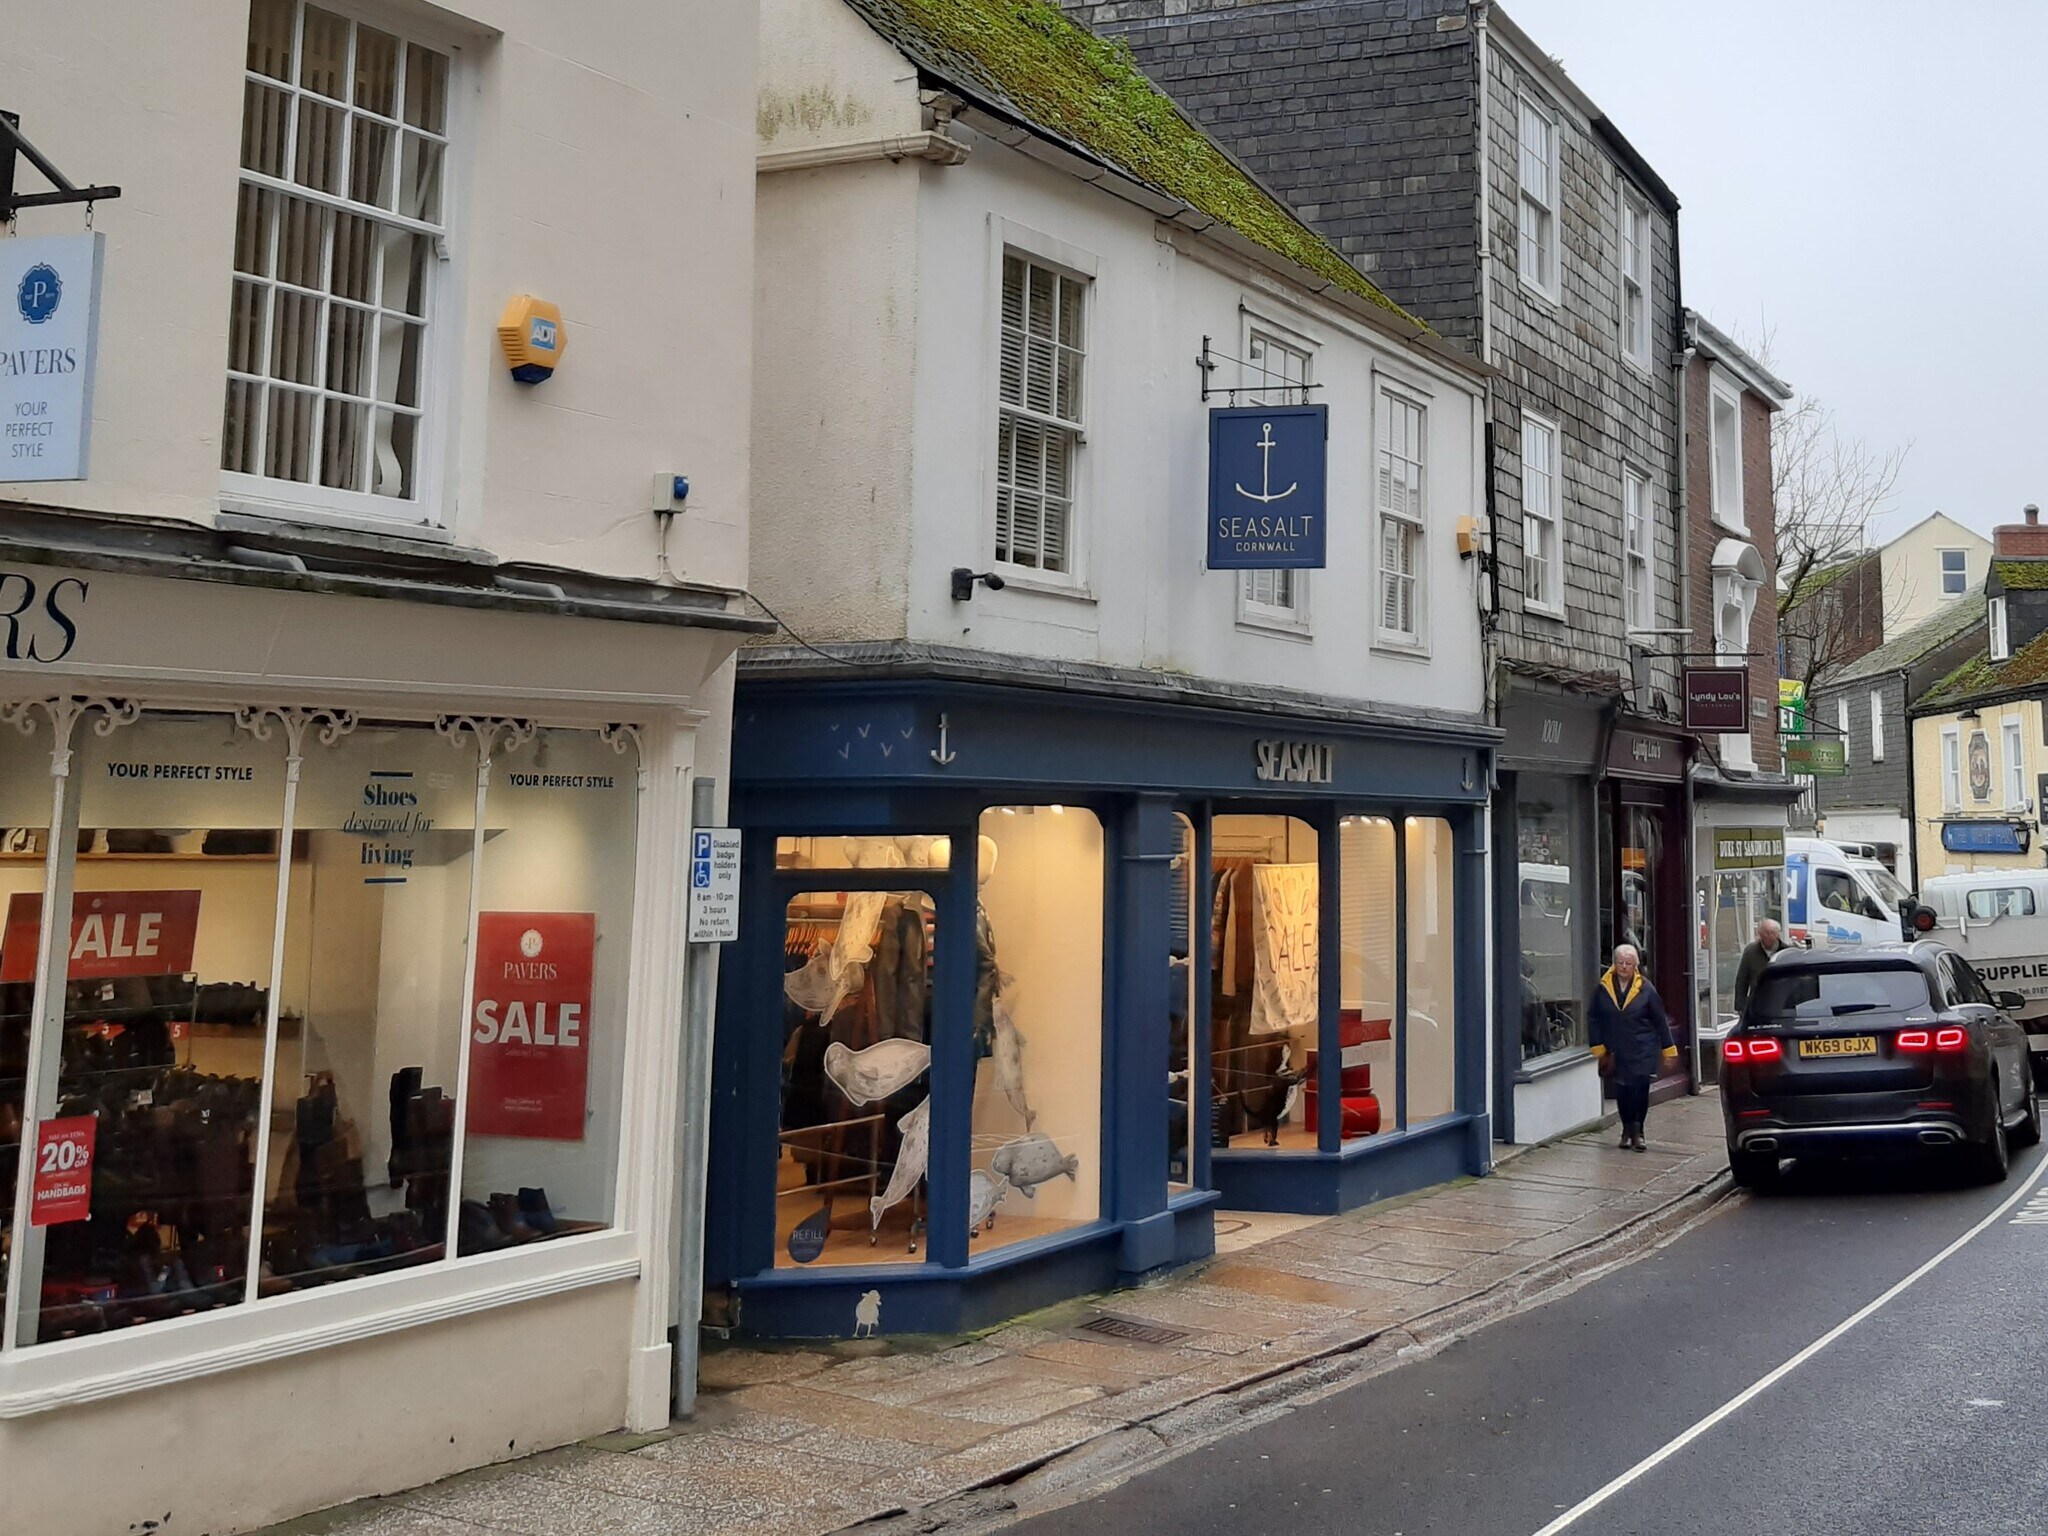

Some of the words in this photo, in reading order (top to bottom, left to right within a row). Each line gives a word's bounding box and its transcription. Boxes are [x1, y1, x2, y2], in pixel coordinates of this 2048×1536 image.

[32, 281, 47, 308] P
[532, 325, 556, 345] ADT
[15, 402, 48, 416] YOUR
[5, 422, 54, 437] PERFECT
[12, 443, 44, 457] STYLE
[1219, 516, 1313, 539] SEASALT
[1236, 541, 1295, 552] CORNWALL
[1690, 692, 1716, 702] Lyndy
[1257, 740, 1333, 783] SEASALT
[108, 763, 149, 777] YOUR
[154, 765, 211, 779] PERFECT
[215, 767, 253, 780] STYLE
[510, 774, 539, 786] YOUR
[542, 775, 584, 787] PERFECT
[586, 776, 614, 788] STYLE
[364, 784, 418, 806] Shoes
[343, 811, 411, 833] designed
[407, 812, 434, 838] for
[713, 840, 739, 848] Disabled
[361, 842, 414, 870] living
[717, 851, 735, 860] badge
[714, 861, 736, 869] holders
[718, 871, 732, 880] only
[709, 906, 726, 914] hours
[700, 918, 708, 926] No
[69, 912, 163, 960] ALE
[694, 929, 713, 937] within
[720, 928, 733, 936] hour
[503, 962, 557, 980] PAVERS
[1976, 964, 2048, 981] SUPPLIE
[474, 1000, 581, 1046] SALE
[1805, 1041, 1840, 1054] WK69
[1844, 1038, 1871, 1052] GJX
[41, 1141, 89, 1172] 20%
[37, 1184, 87, 1200] HANDBAGS
[793, 1230, 824, 1240] REFILL
